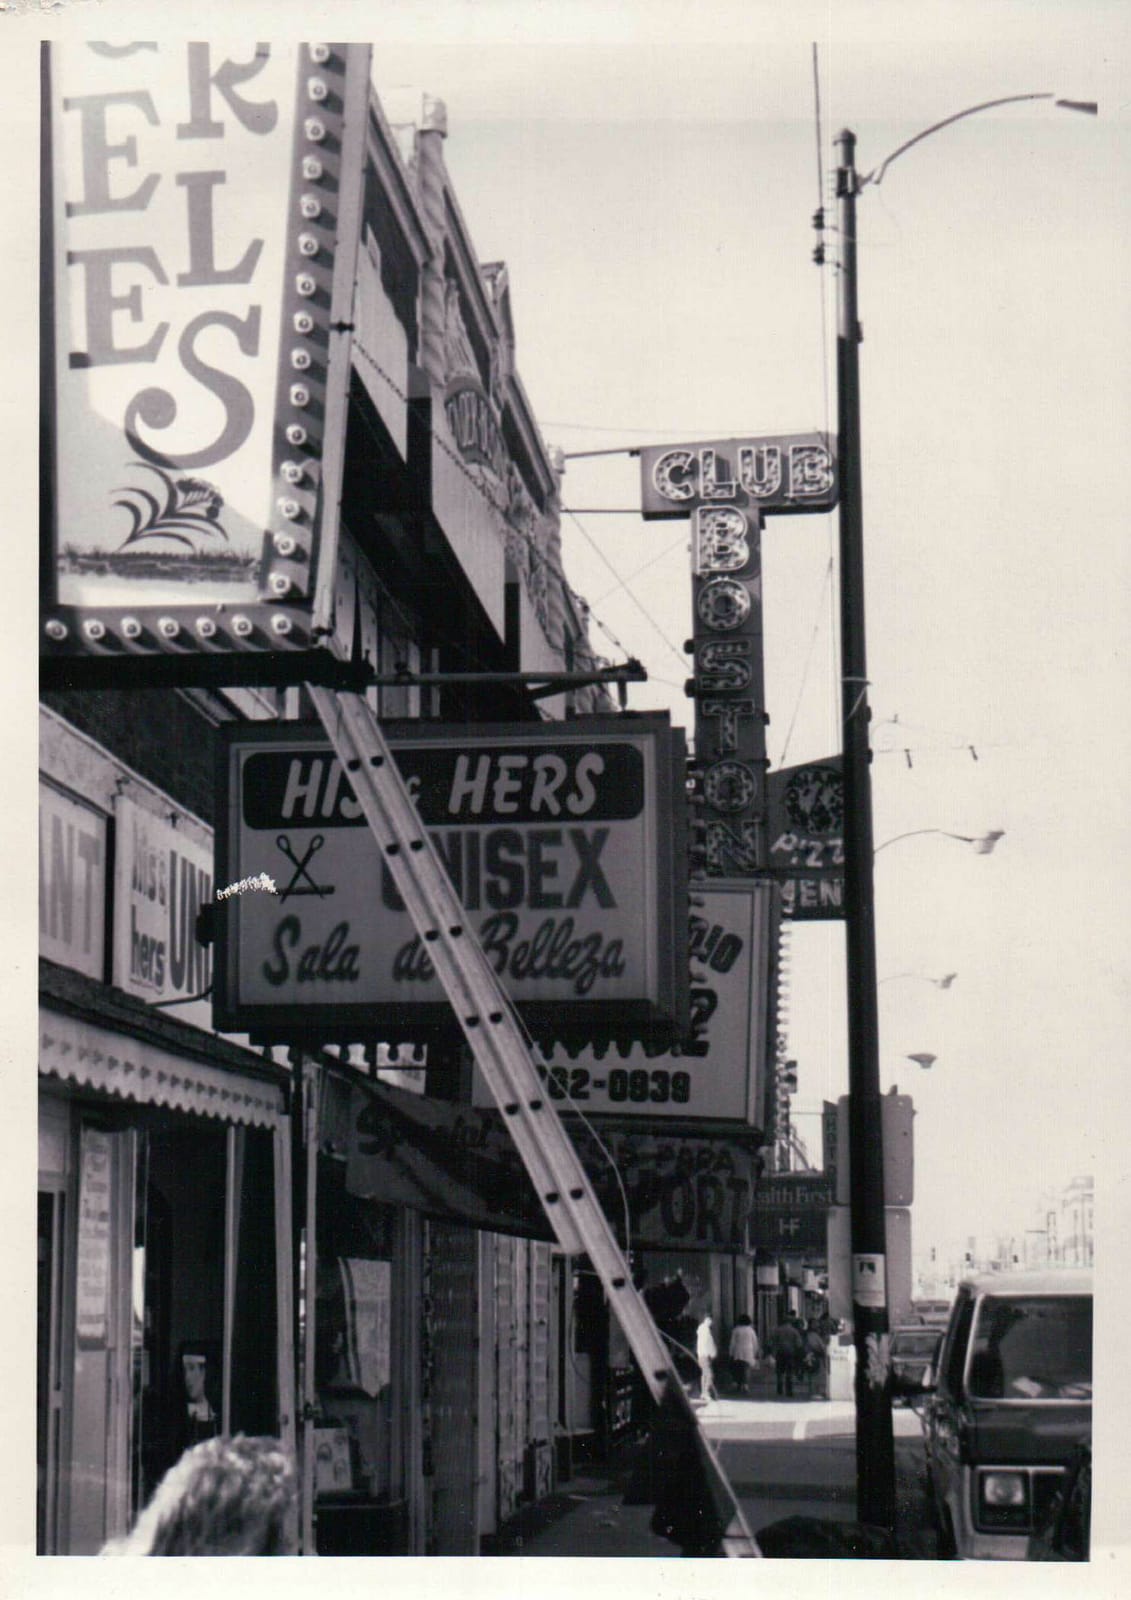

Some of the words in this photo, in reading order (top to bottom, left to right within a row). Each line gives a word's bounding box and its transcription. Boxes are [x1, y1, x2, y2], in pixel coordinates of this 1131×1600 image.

[652, 443, 834, 501] CLUB
[696, 504, 760, 878] BOSTON
[448, 752, 605, 817] HERS
[263, 914, 361, 986] Sala
[480, 911, 626, 995] Belleza
